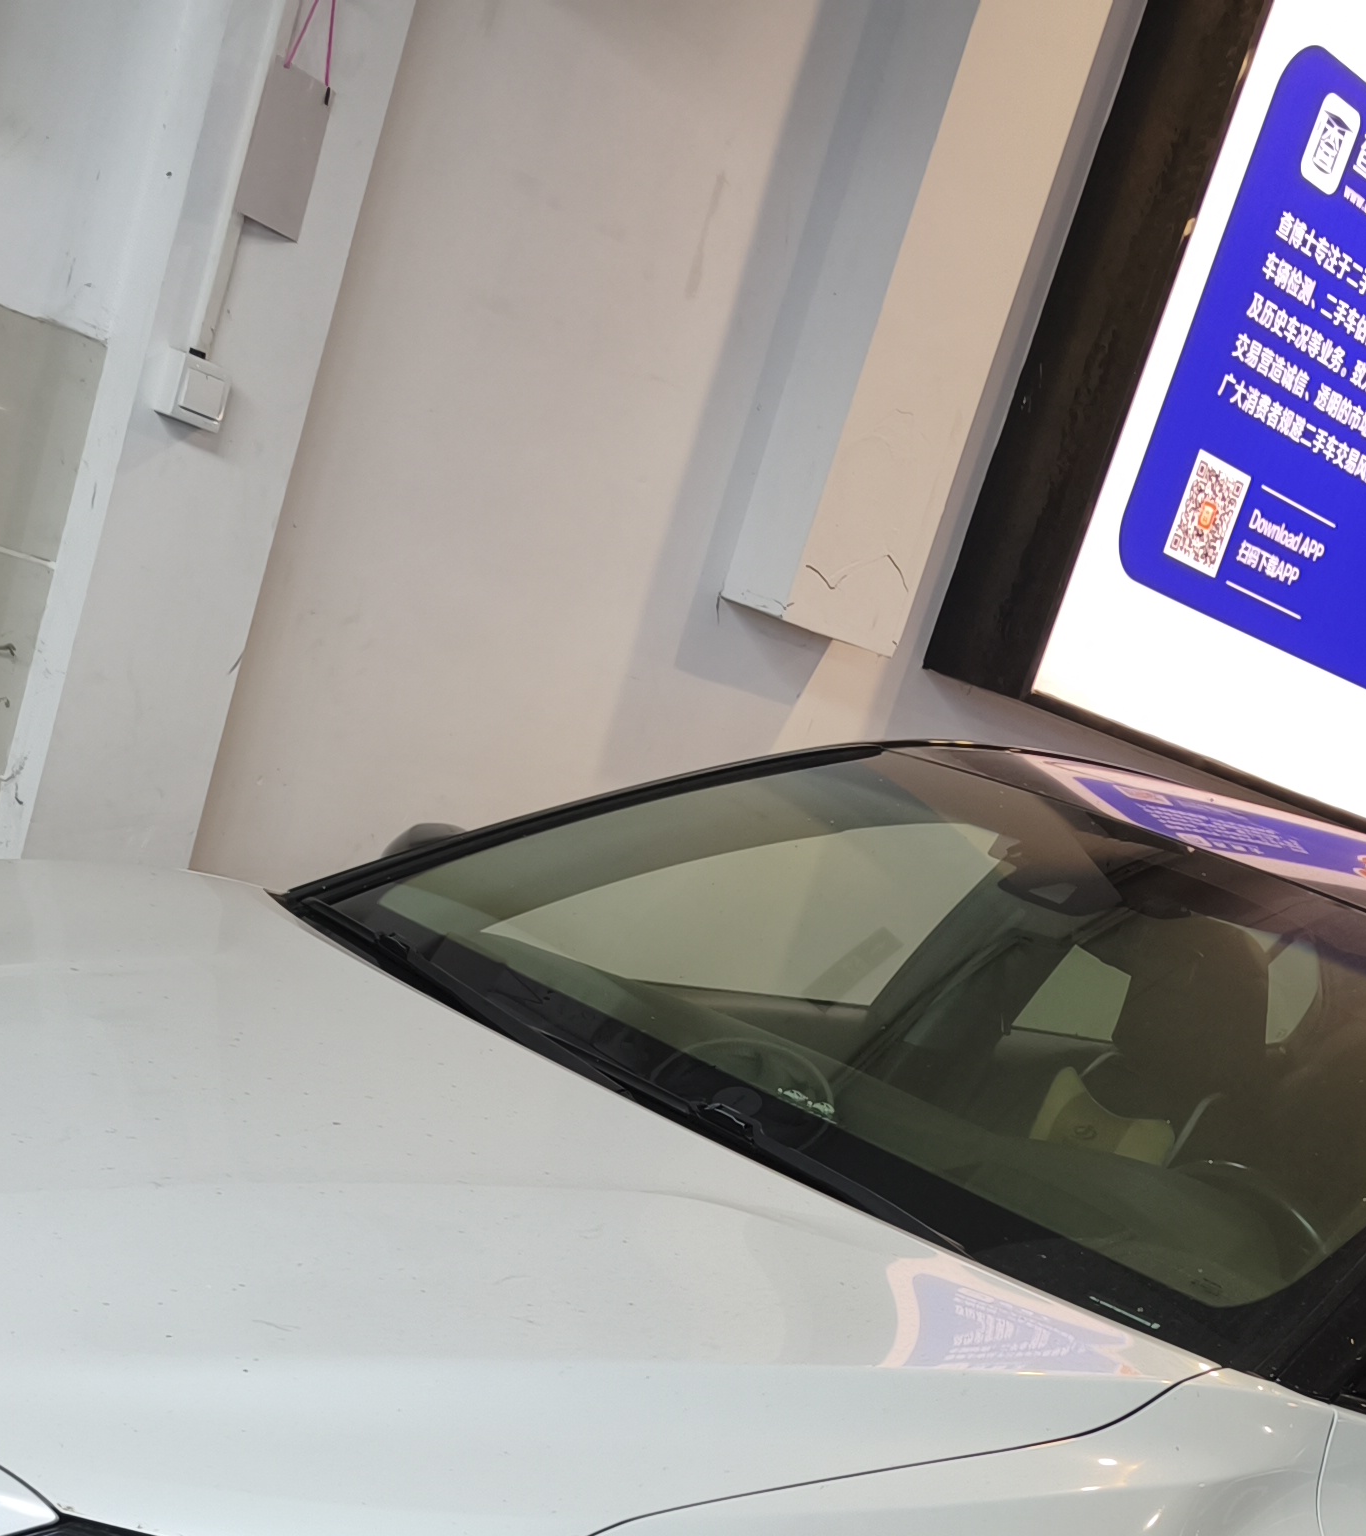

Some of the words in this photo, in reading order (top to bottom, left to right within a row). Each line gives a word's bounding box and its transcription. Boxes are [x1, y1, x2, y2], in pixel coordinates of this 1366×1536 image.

[1248, 508, 1303, 553] Download
[1298, 537, 1325, 562] APP
[1235, 539, 1300, 586] 扫码下载APP
